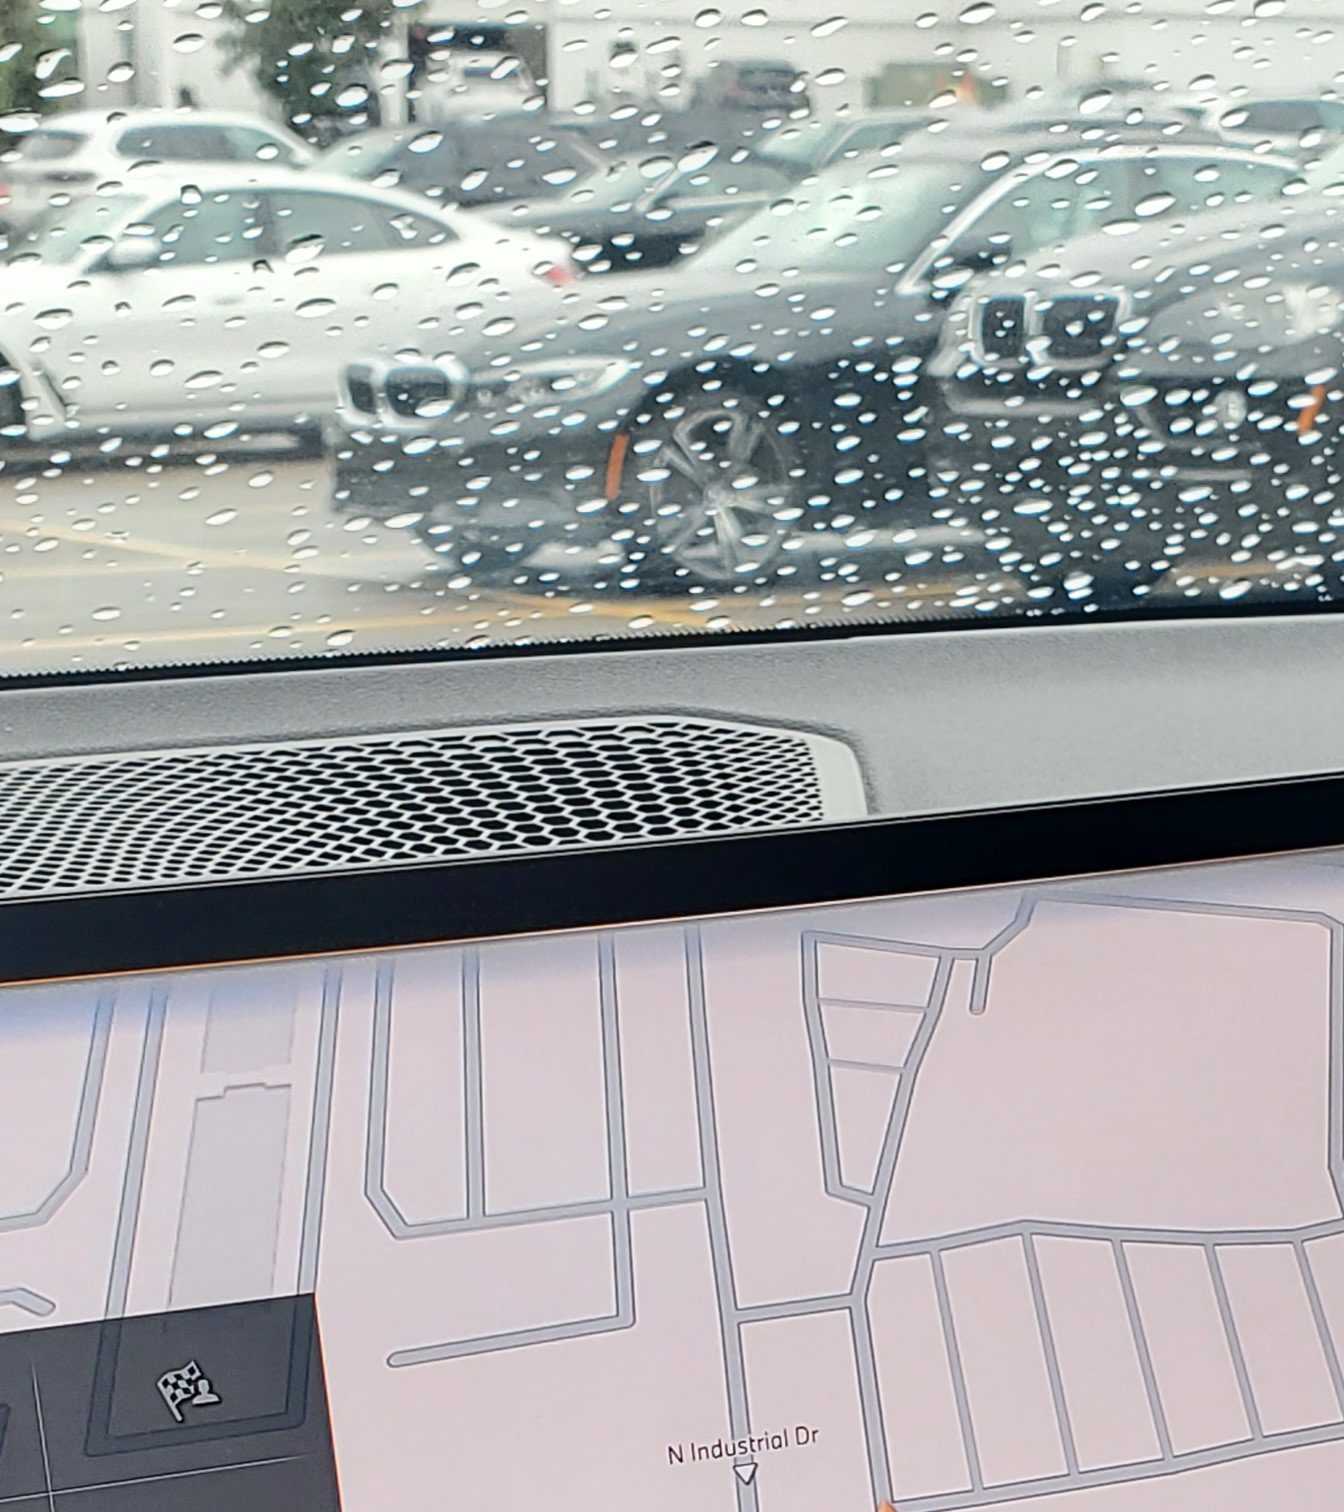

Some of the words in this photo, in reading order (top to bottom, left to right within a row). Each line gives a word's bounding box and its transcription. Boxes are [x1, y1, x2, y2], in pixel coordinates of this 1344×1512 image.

[667, 1444, 685, 1464] N
[690, 1427, 789, 1461] Industrial
[794, 1425, 820, 1446] Dr
